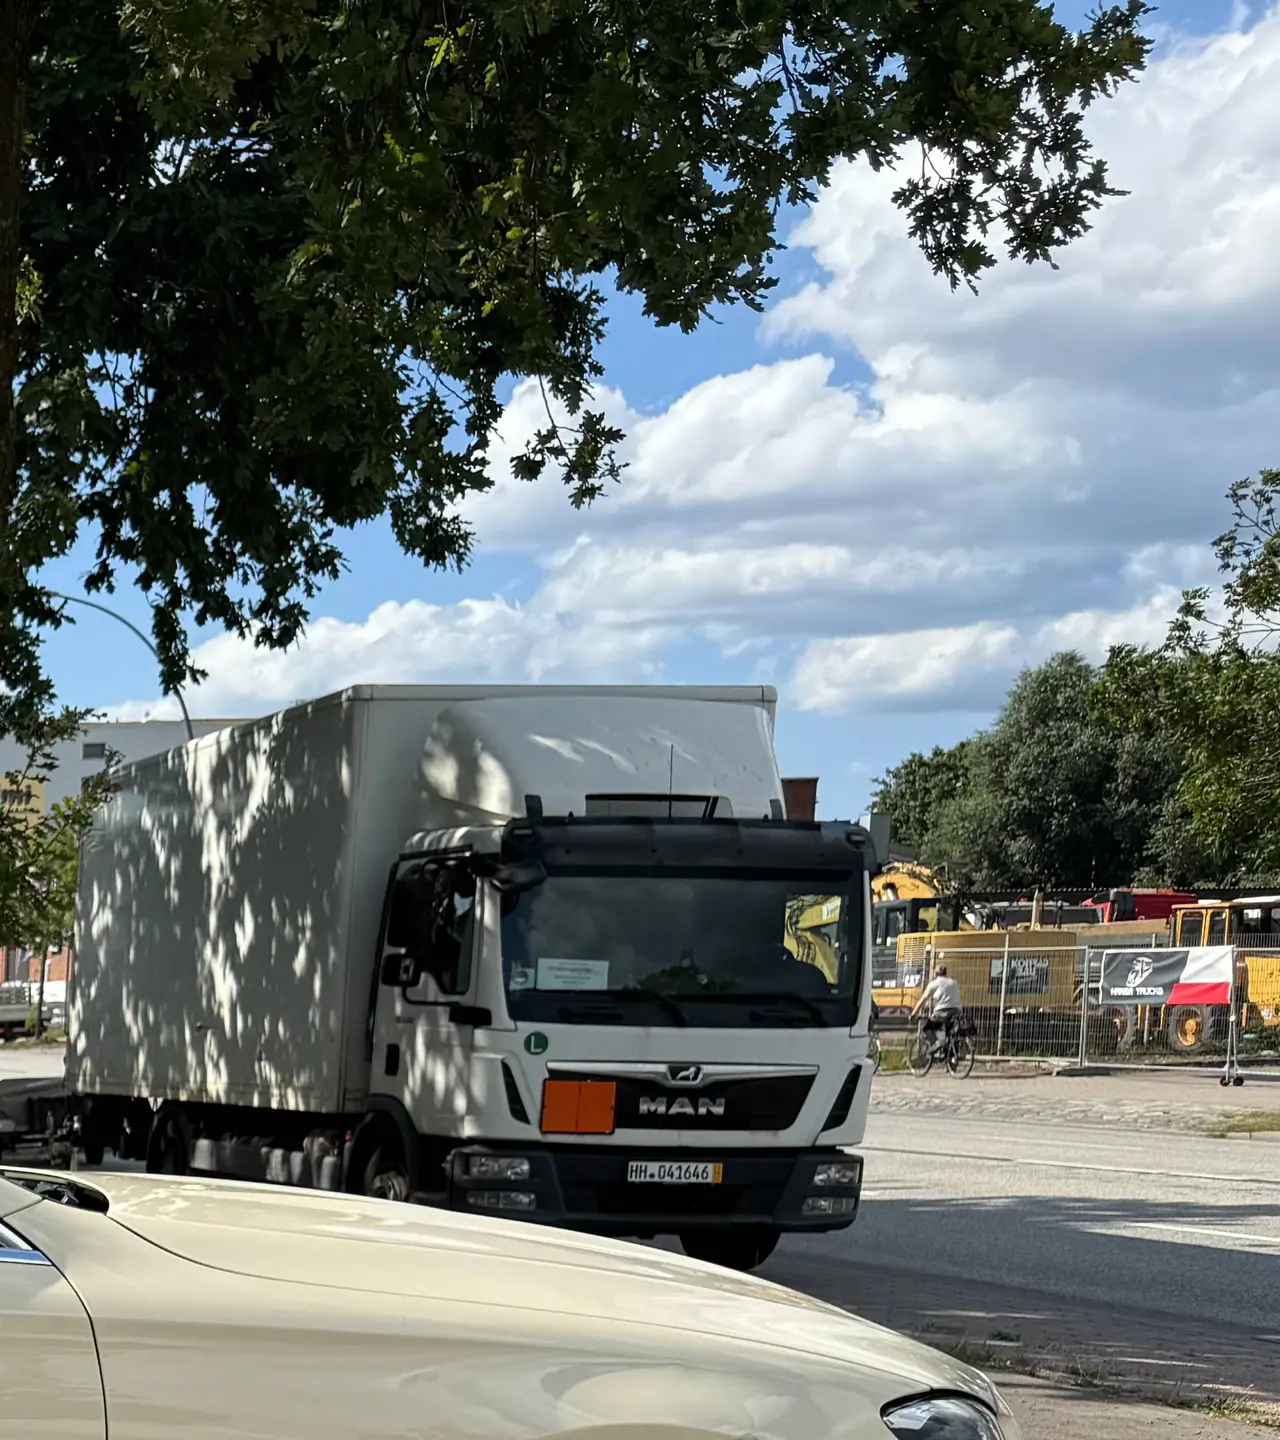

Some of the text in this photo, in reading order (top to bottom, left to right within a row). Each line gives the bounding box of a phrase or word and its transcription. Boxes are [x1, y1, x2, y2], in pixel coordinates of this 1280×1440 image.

[1136, 986, 1164, 996] TRUCKS
[530, 1035, 543, 1053] L
[639, 1096, 726, 1116] MAN
[629, 1163, 709, 1181] HH 041646
